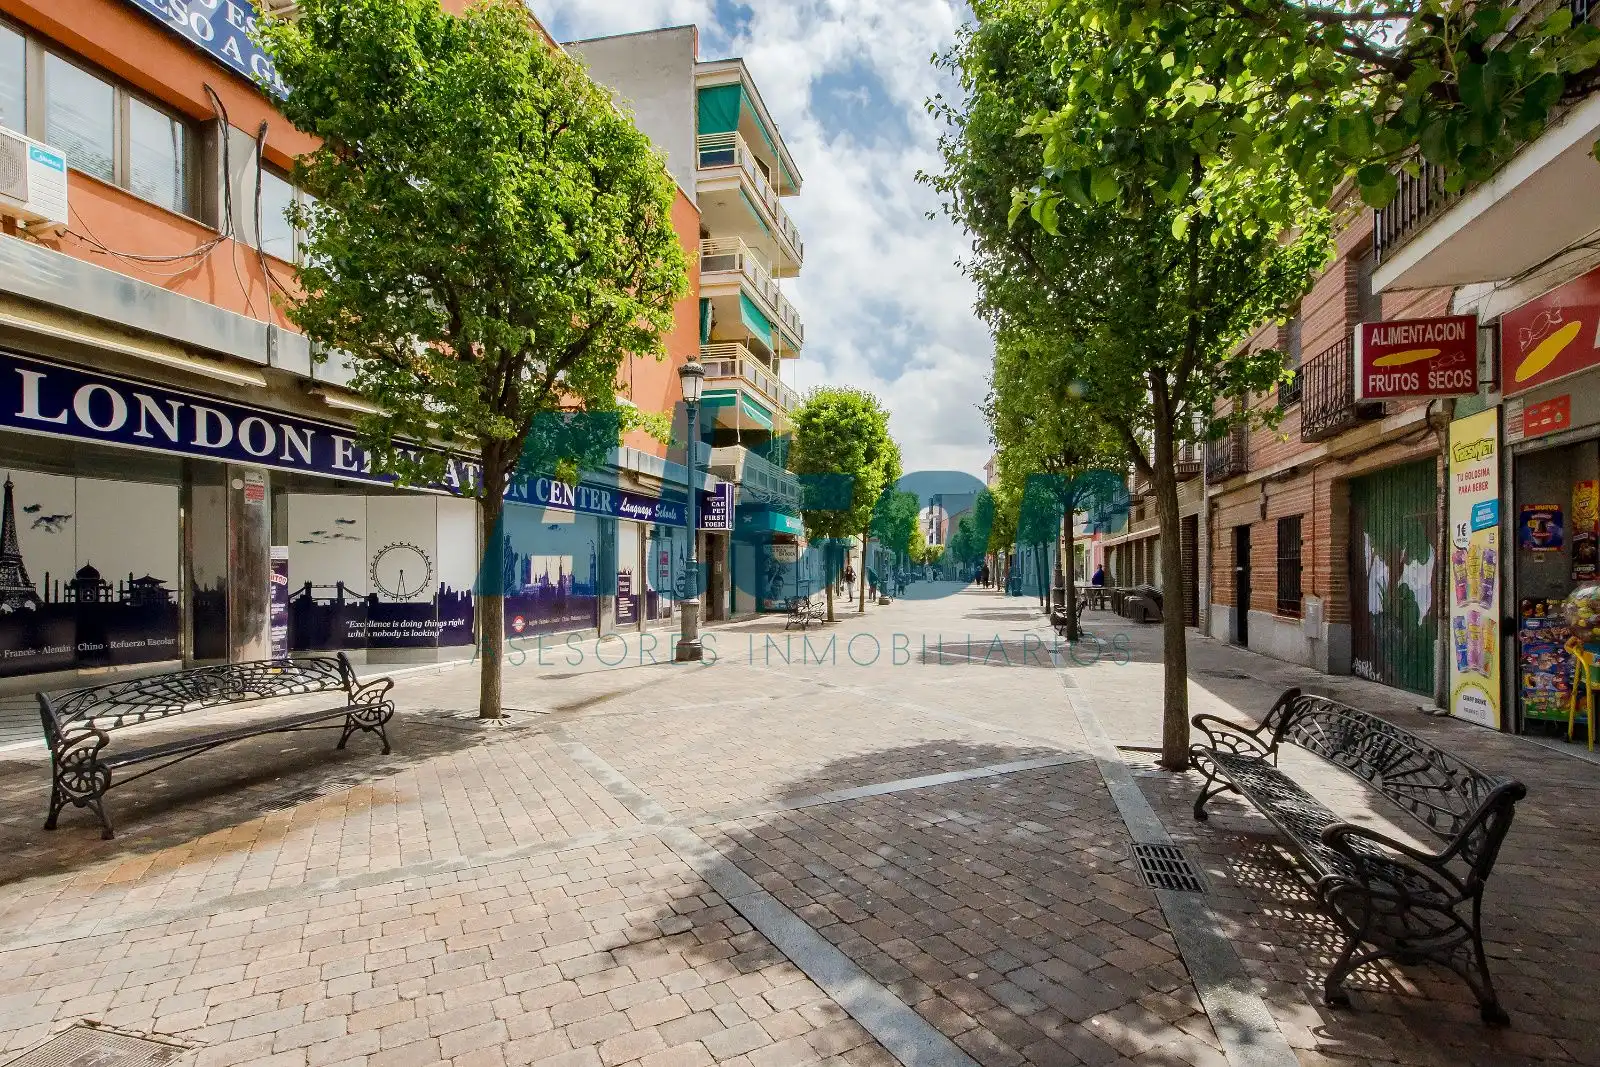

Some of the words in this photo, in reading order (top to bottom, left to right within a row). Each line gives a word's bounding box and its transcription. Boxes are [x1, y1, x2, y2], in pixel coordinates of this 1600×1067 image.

[221, 35, 245, 66] A
[1371, 321, 1466, 346] ALIMENTACION
[1368, 372, 1419, 393] FRUTOS
[1428, 369, 1473, 390] SECOS
[14, 368, 316, 465] LONDON
[536, 477, 613, 512] CENTER
[620, 497, 653, 521] Language
[654, 503, 677, 520] Schools
[1473, 481, 1489, 492] BEBER
[372, 629, 402, 639] nobody
[403, 629, 410, 637] is
[392, 620, 399, 628] is
[400, 620, 423, 629] doing
[424, 619, 447, 629] things
[448, 618, 465, 628] right
[4, 647, 36, 659] Francés
[42, 645, 71, 655] Alemán
[78, 642, 104, 651] Chino
[110, 639, 146, 649] Refuerzo
[147, 637, 175, 646] Escolar
